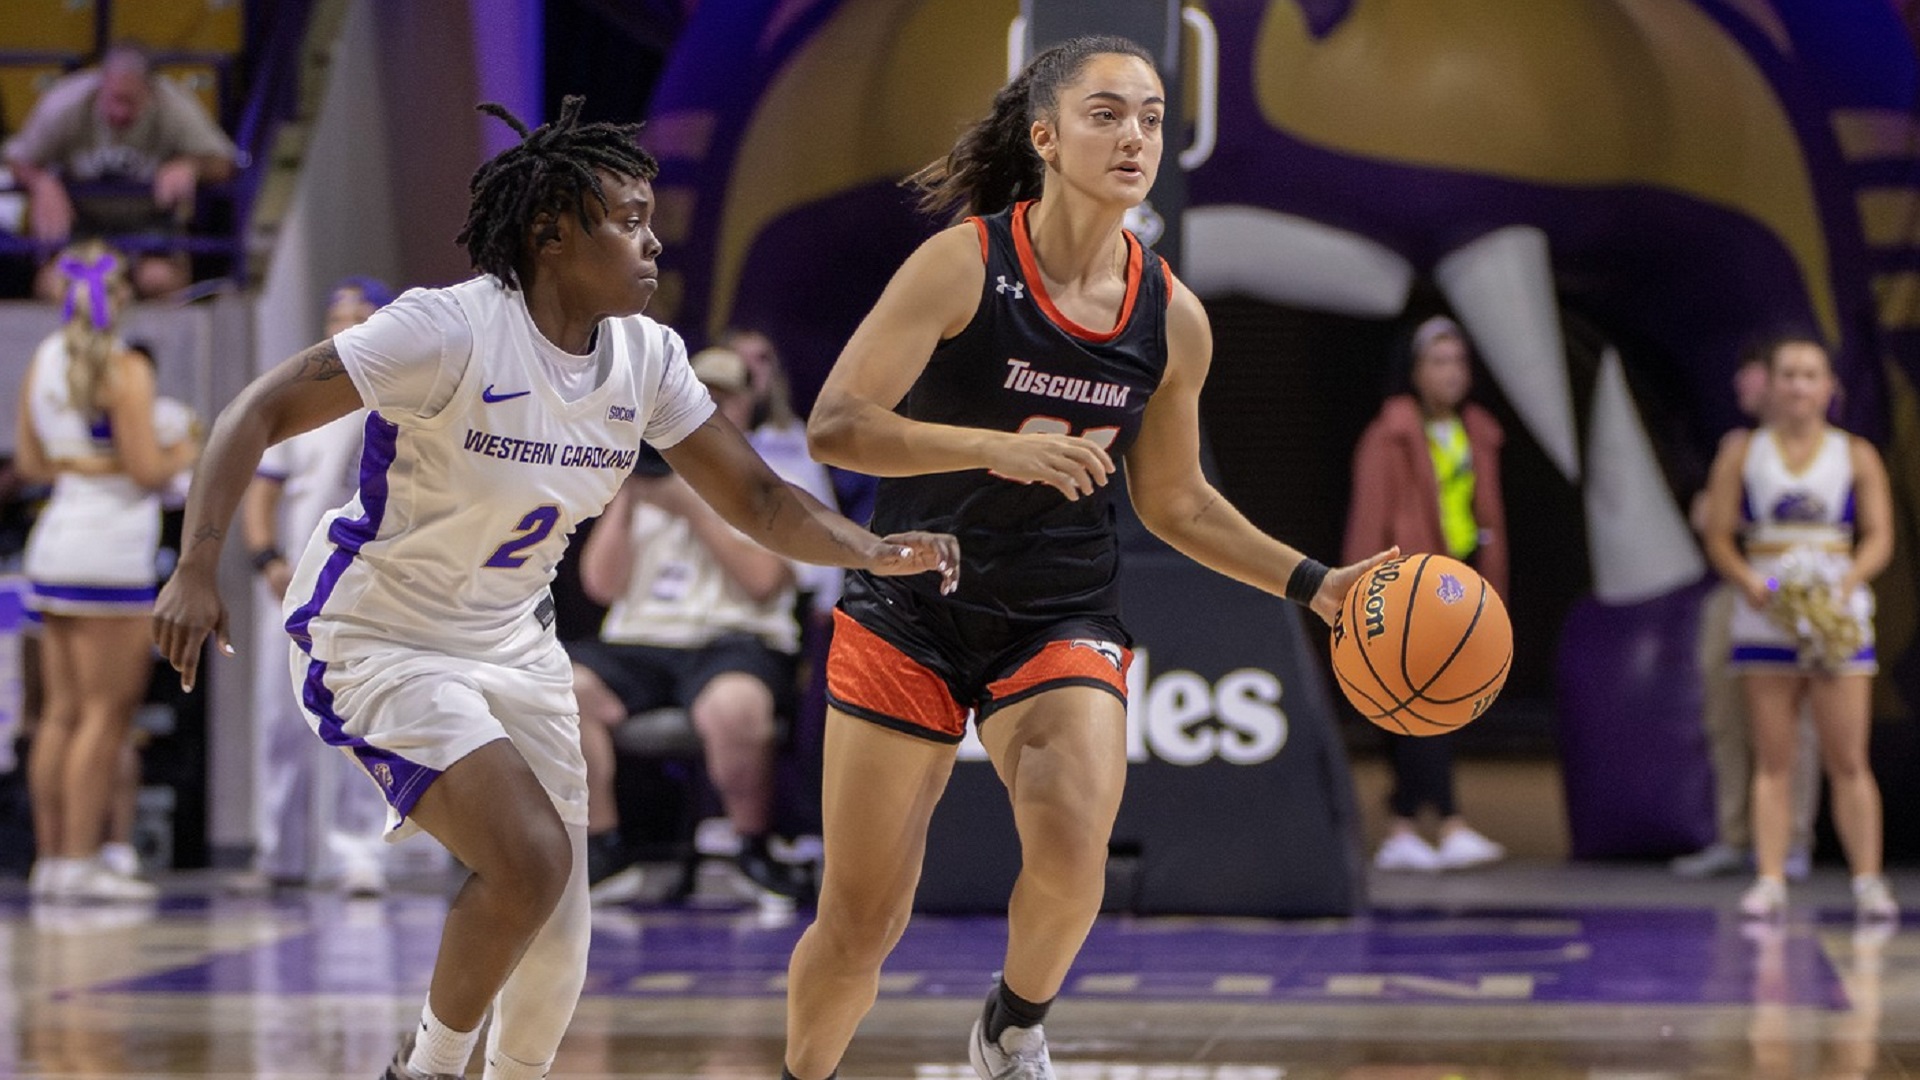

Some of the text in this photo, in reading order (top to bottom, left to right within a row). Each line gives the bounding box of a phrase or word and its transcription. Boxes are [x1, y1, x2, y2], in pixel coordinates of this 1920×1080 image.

[1003, 358, 1131, 408] TUSCULUM
[464, 429, 636, 470] WESTERN CAROLINA
[482, 504, 561, 567] 2
